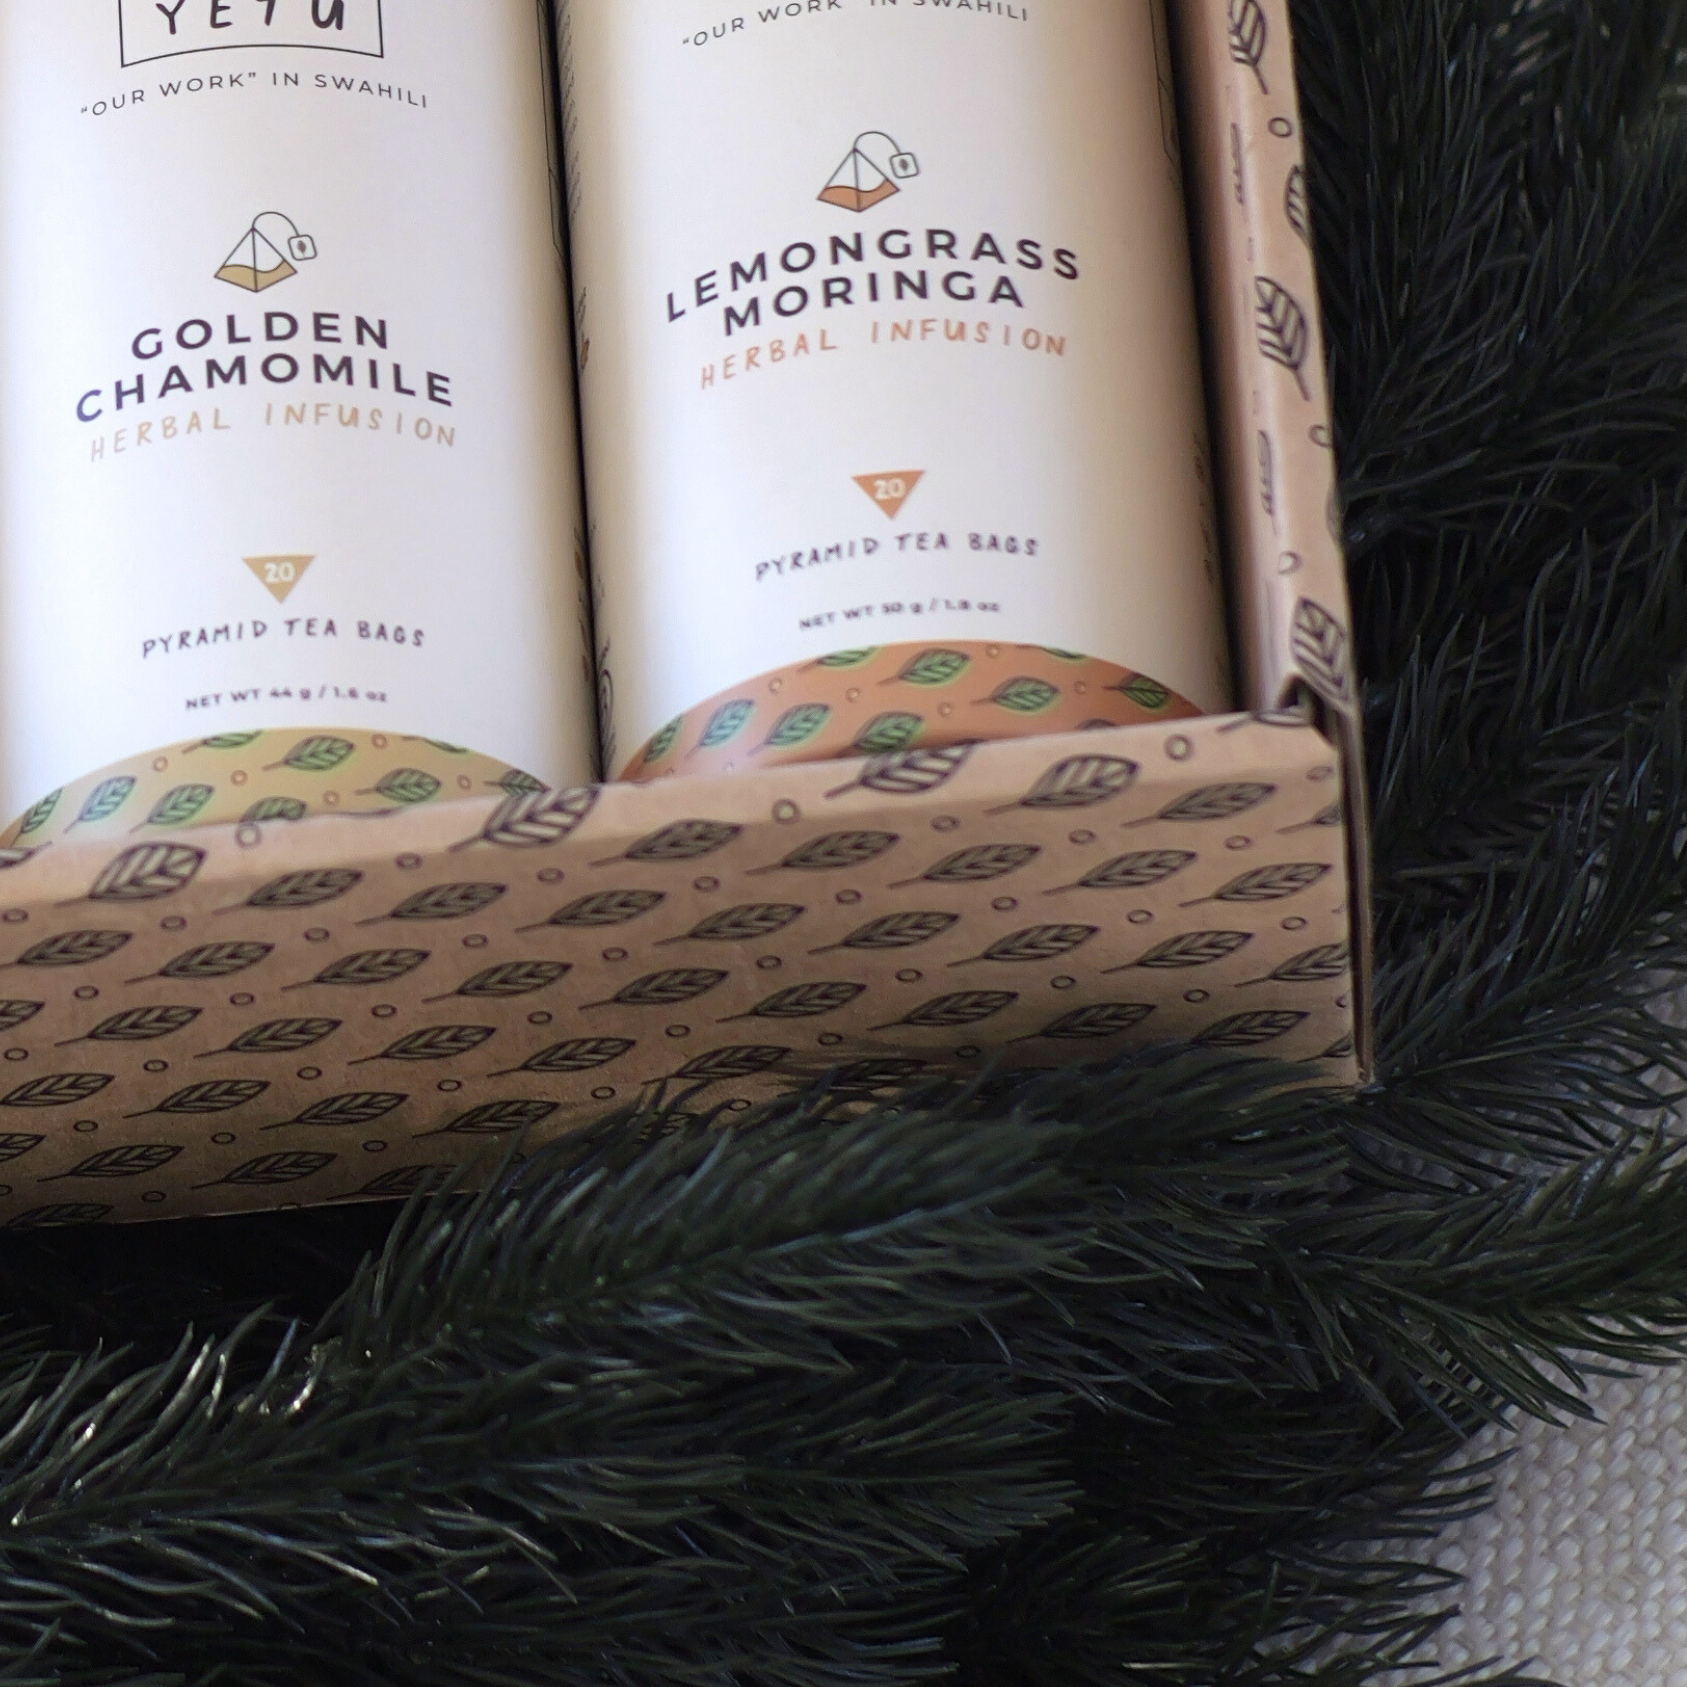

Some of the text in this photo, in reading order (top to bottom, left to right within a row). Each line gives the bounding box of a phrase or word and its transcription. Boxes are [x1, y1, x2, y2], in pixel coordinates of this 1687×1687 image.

[273, 73, 299, 87] IN
[315, 75, 427, 108] SWAHILI
[667, 229, 1079, 322] LEMONGRASS
[724, 270, 1024, 335] MORINGA
[131, 312, 388, 359] GOLDEN
[701, 319, 1066, 390] HERBAL INFUSION
[76, 352, 452, 423] CHAMOMILE
[91, 402, 455, 462] HERBAL INFUSION
[874, 479, 905, 499] 20
[264, 562, 294, 582] 20
[755, 534, 1038, 581] PYRAMID TEA BAGS
[143, 619, 424, 659] PYRAMID TEA BAGS
